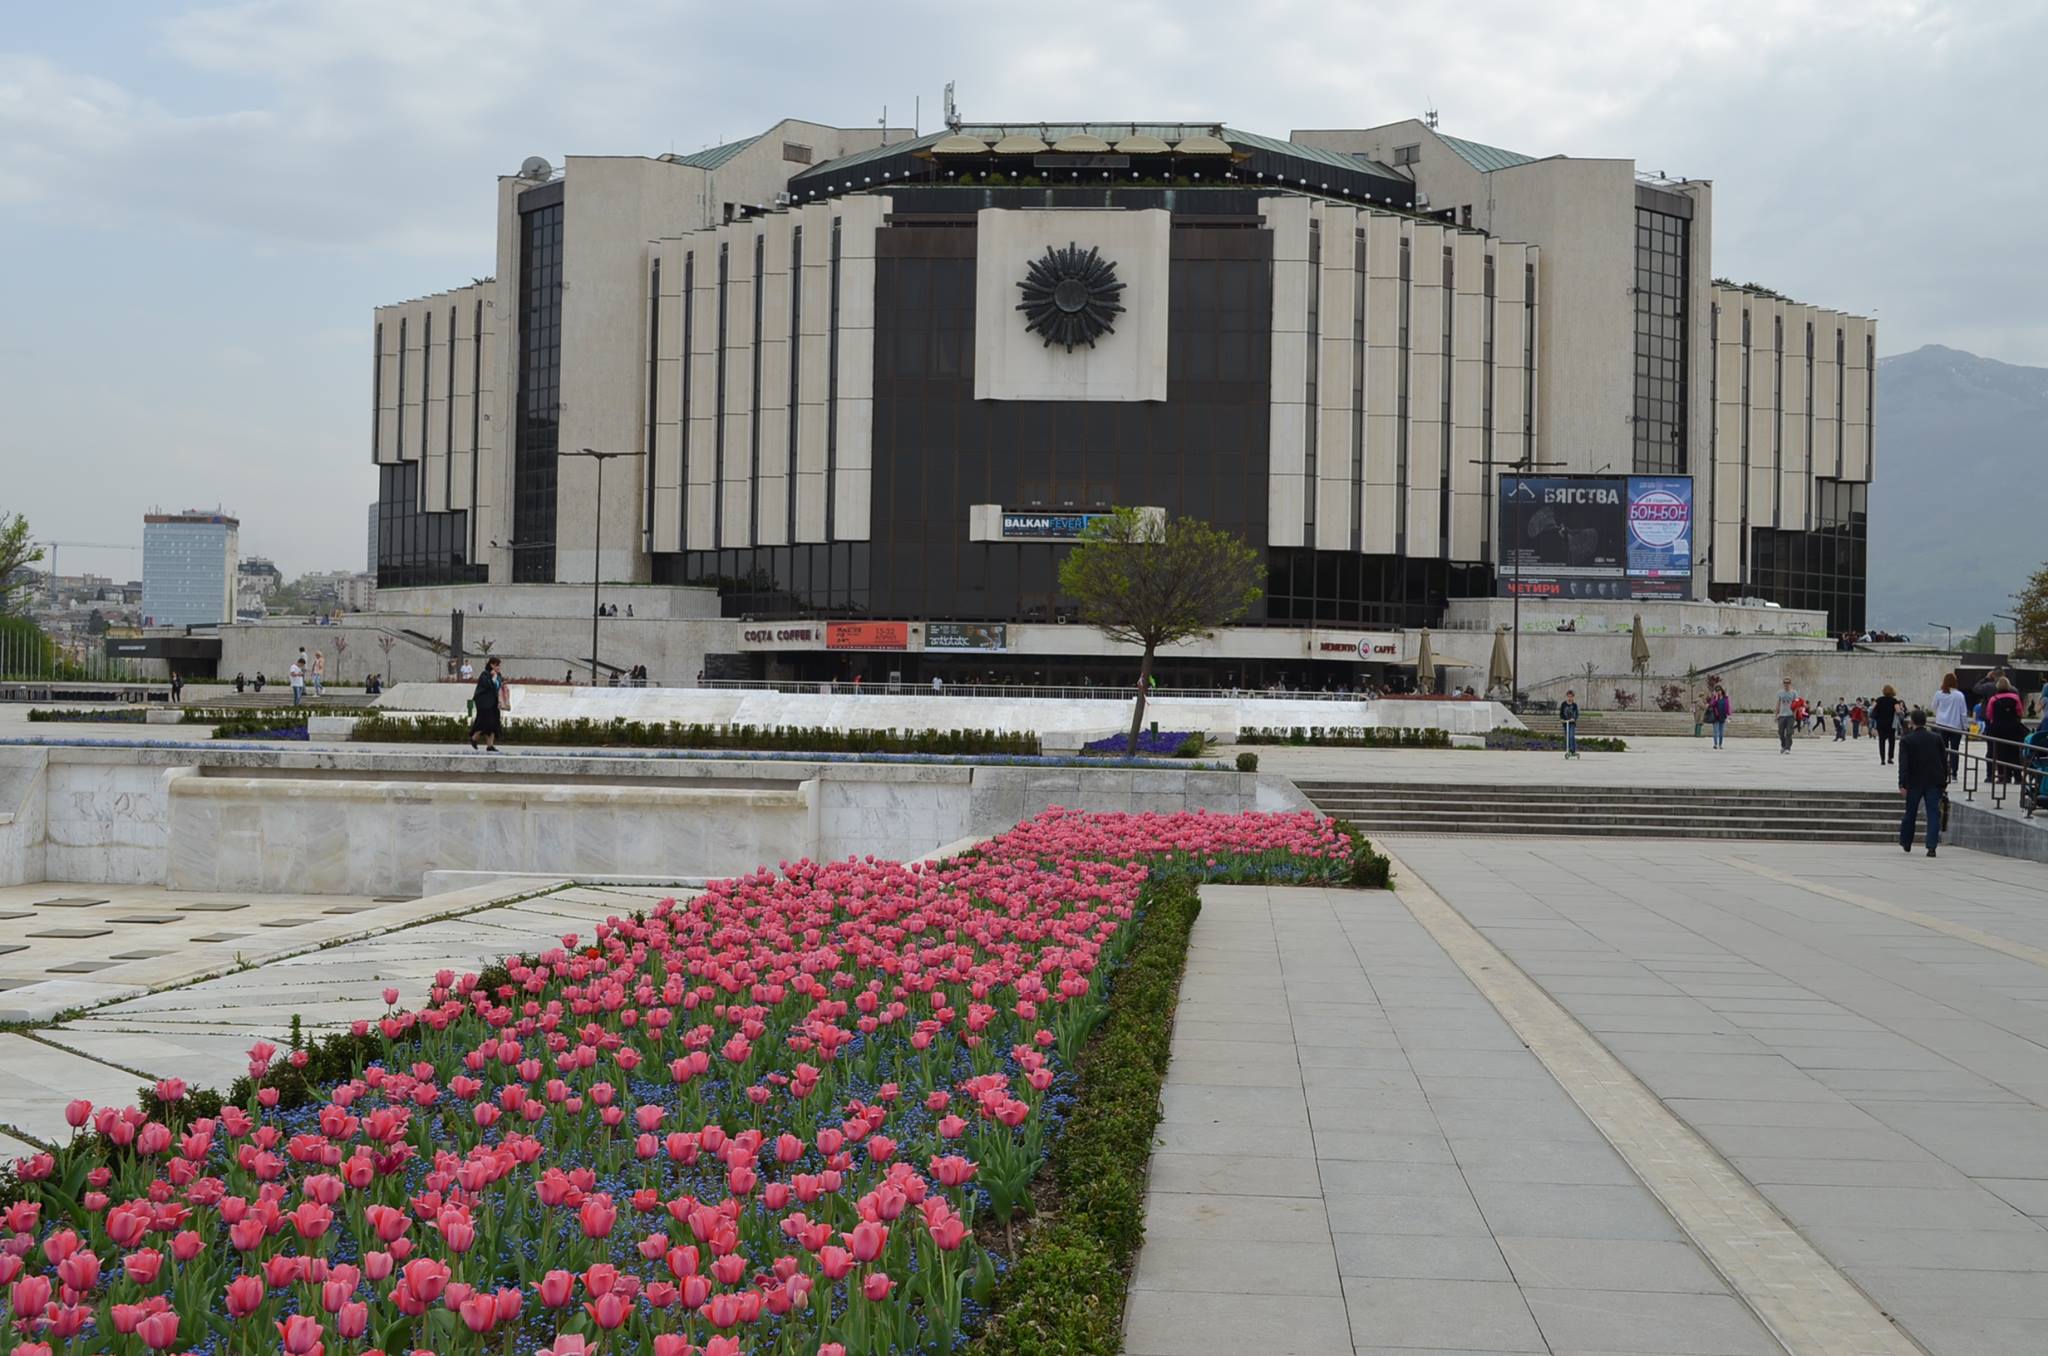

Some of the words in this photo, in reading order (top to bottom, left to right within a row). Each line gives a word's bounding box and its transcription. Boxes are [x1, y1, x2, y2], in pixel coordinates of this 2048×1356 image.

[1544, 488, 1619, 504] БЯГСТВА
[1630, 505, 1688, 520] БОН-БОН
[1004, 518, 1050, 528] BALKAN
[1507, 583, 1560, 594] ЧЕТИРИ
[744, 630, 772, 642] COSTA
[777, 629, 812, 641] COFFEE
[1321, 642, 1356, 652] MEMENTO
